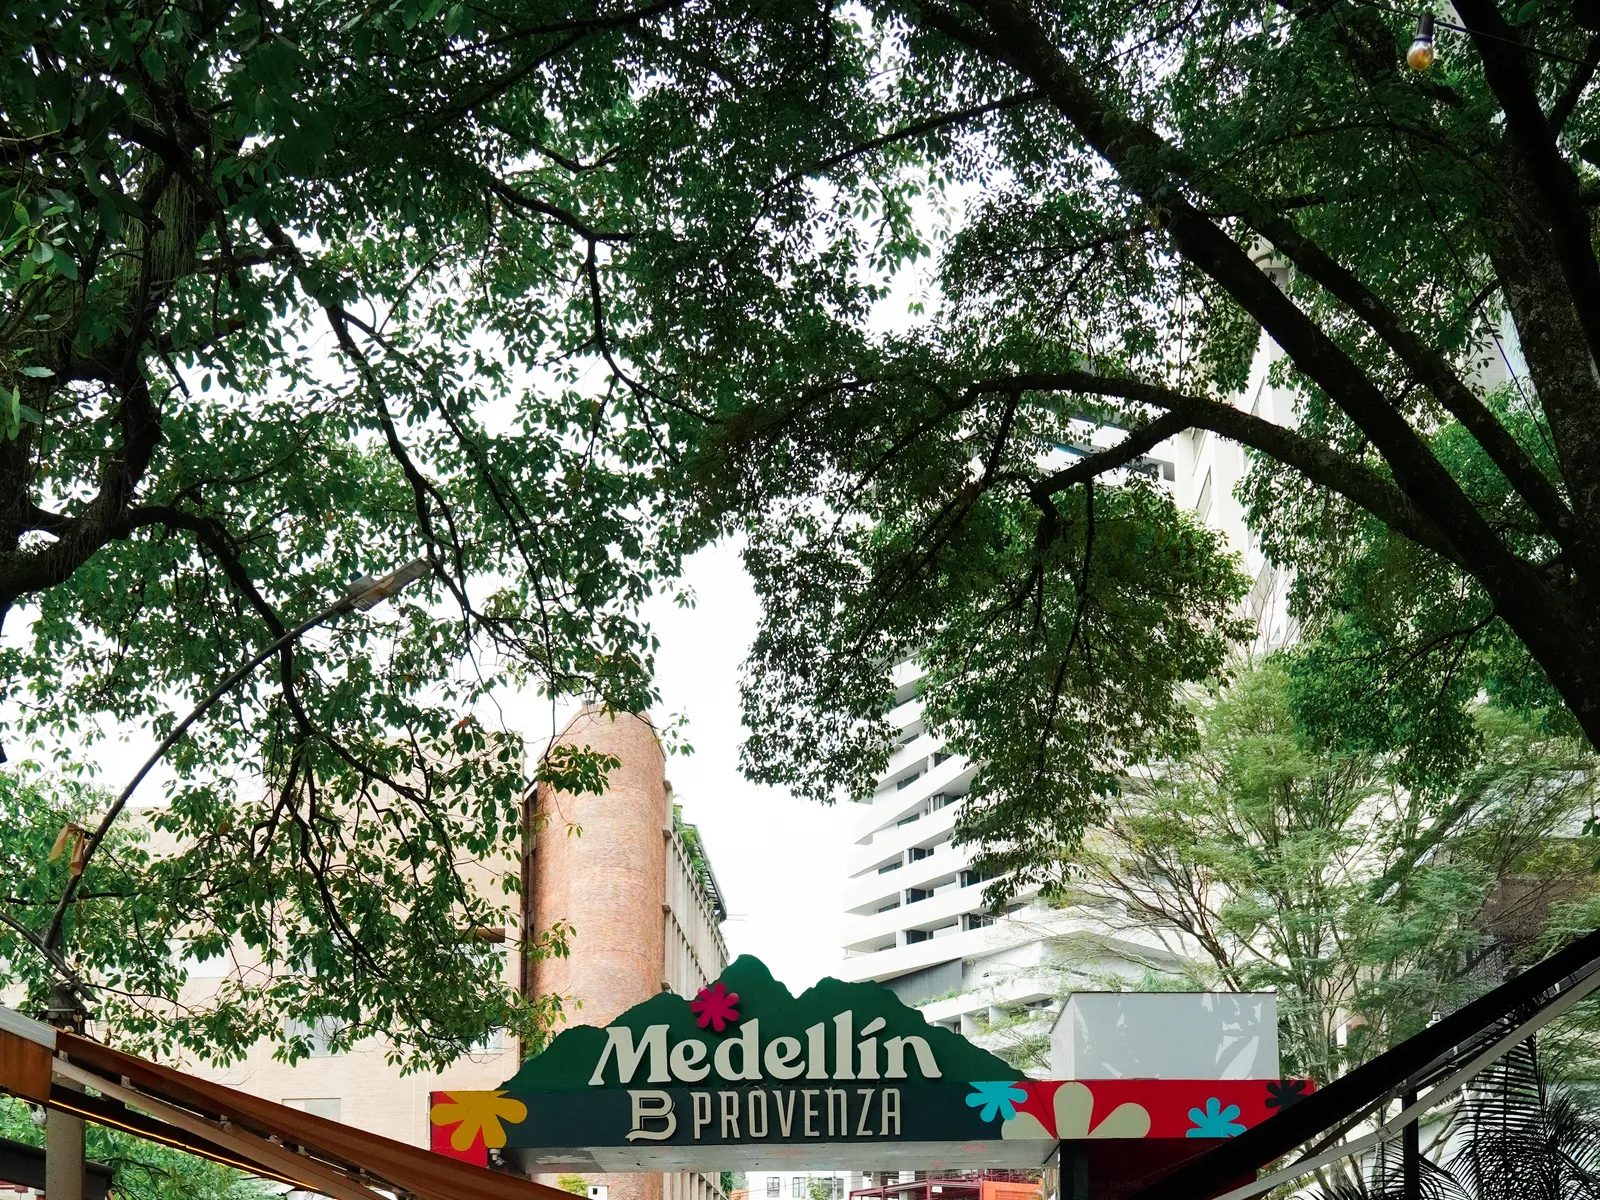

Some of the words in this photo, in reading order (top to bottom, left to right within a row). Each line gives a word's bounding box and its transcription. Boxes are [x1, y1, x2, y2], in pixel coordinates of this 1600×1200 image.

[587, 1009, 943, 1086] Medellín
[625, 1089, 677, 1142] B
[690, 1087, 901, 1139] PROVENZA
